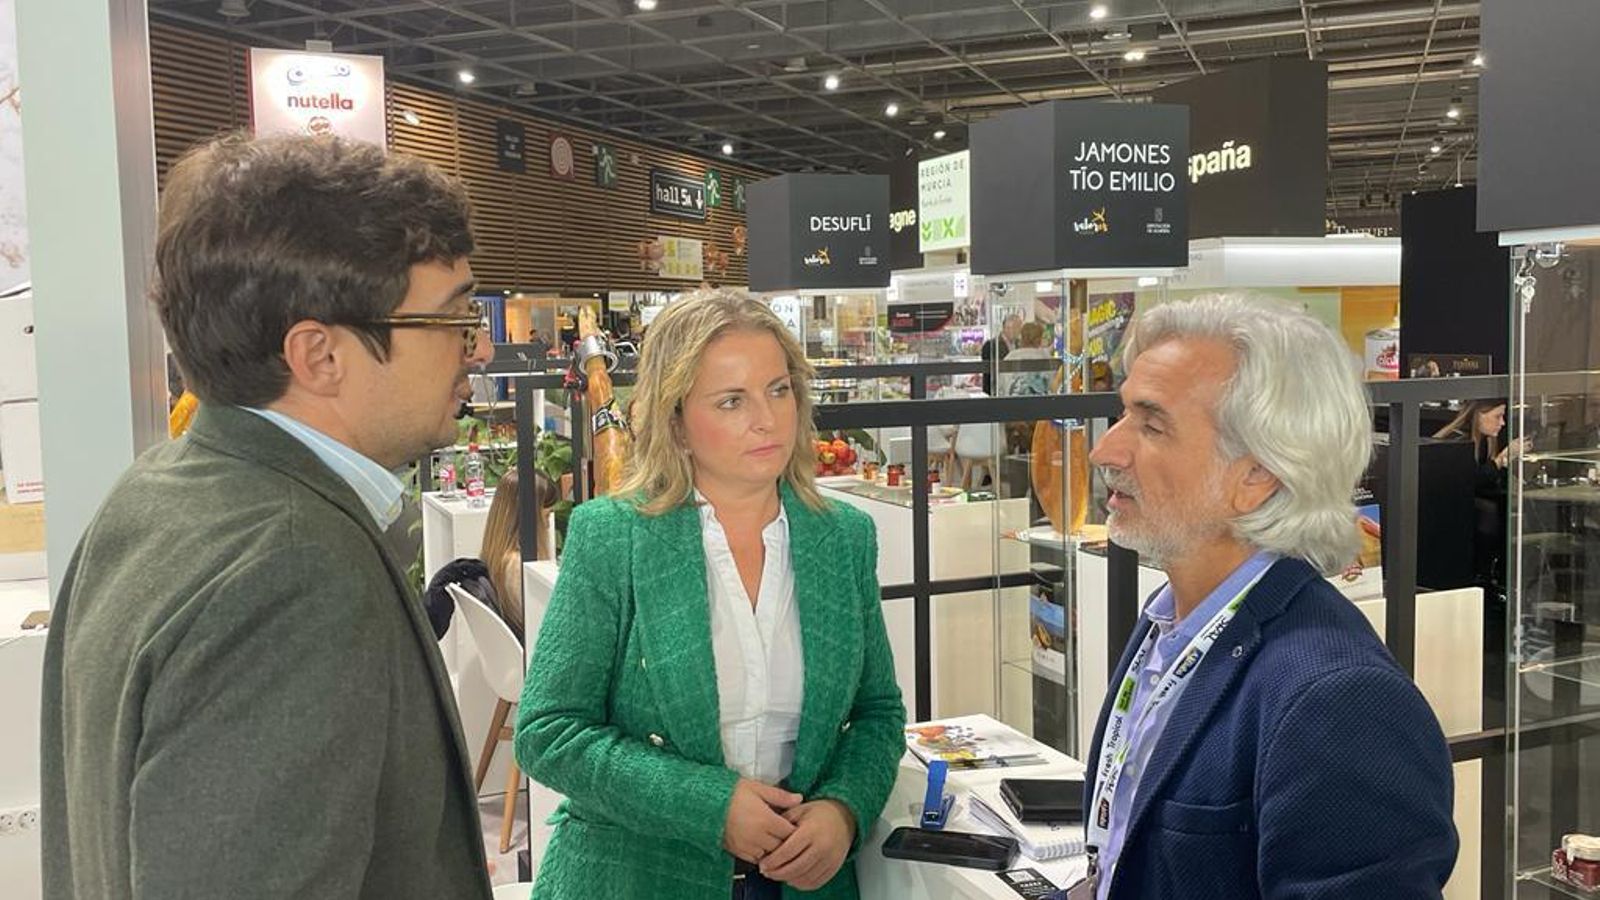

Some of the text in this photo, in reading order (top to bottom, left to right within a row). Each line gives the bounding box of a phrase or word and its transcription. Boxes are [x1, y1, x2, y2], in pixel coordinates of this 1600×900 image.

[286, 92, 353, 110] nutella
[1074, 141, 1171, 164] JAMONES
[1069, 166, 1175, 192] TÍO EMILIO
[655, 183, 680, 205] hall
[810, 213, 872, 231] DESUFLÍ
[1106, 715, 1123, 749] Tropical
